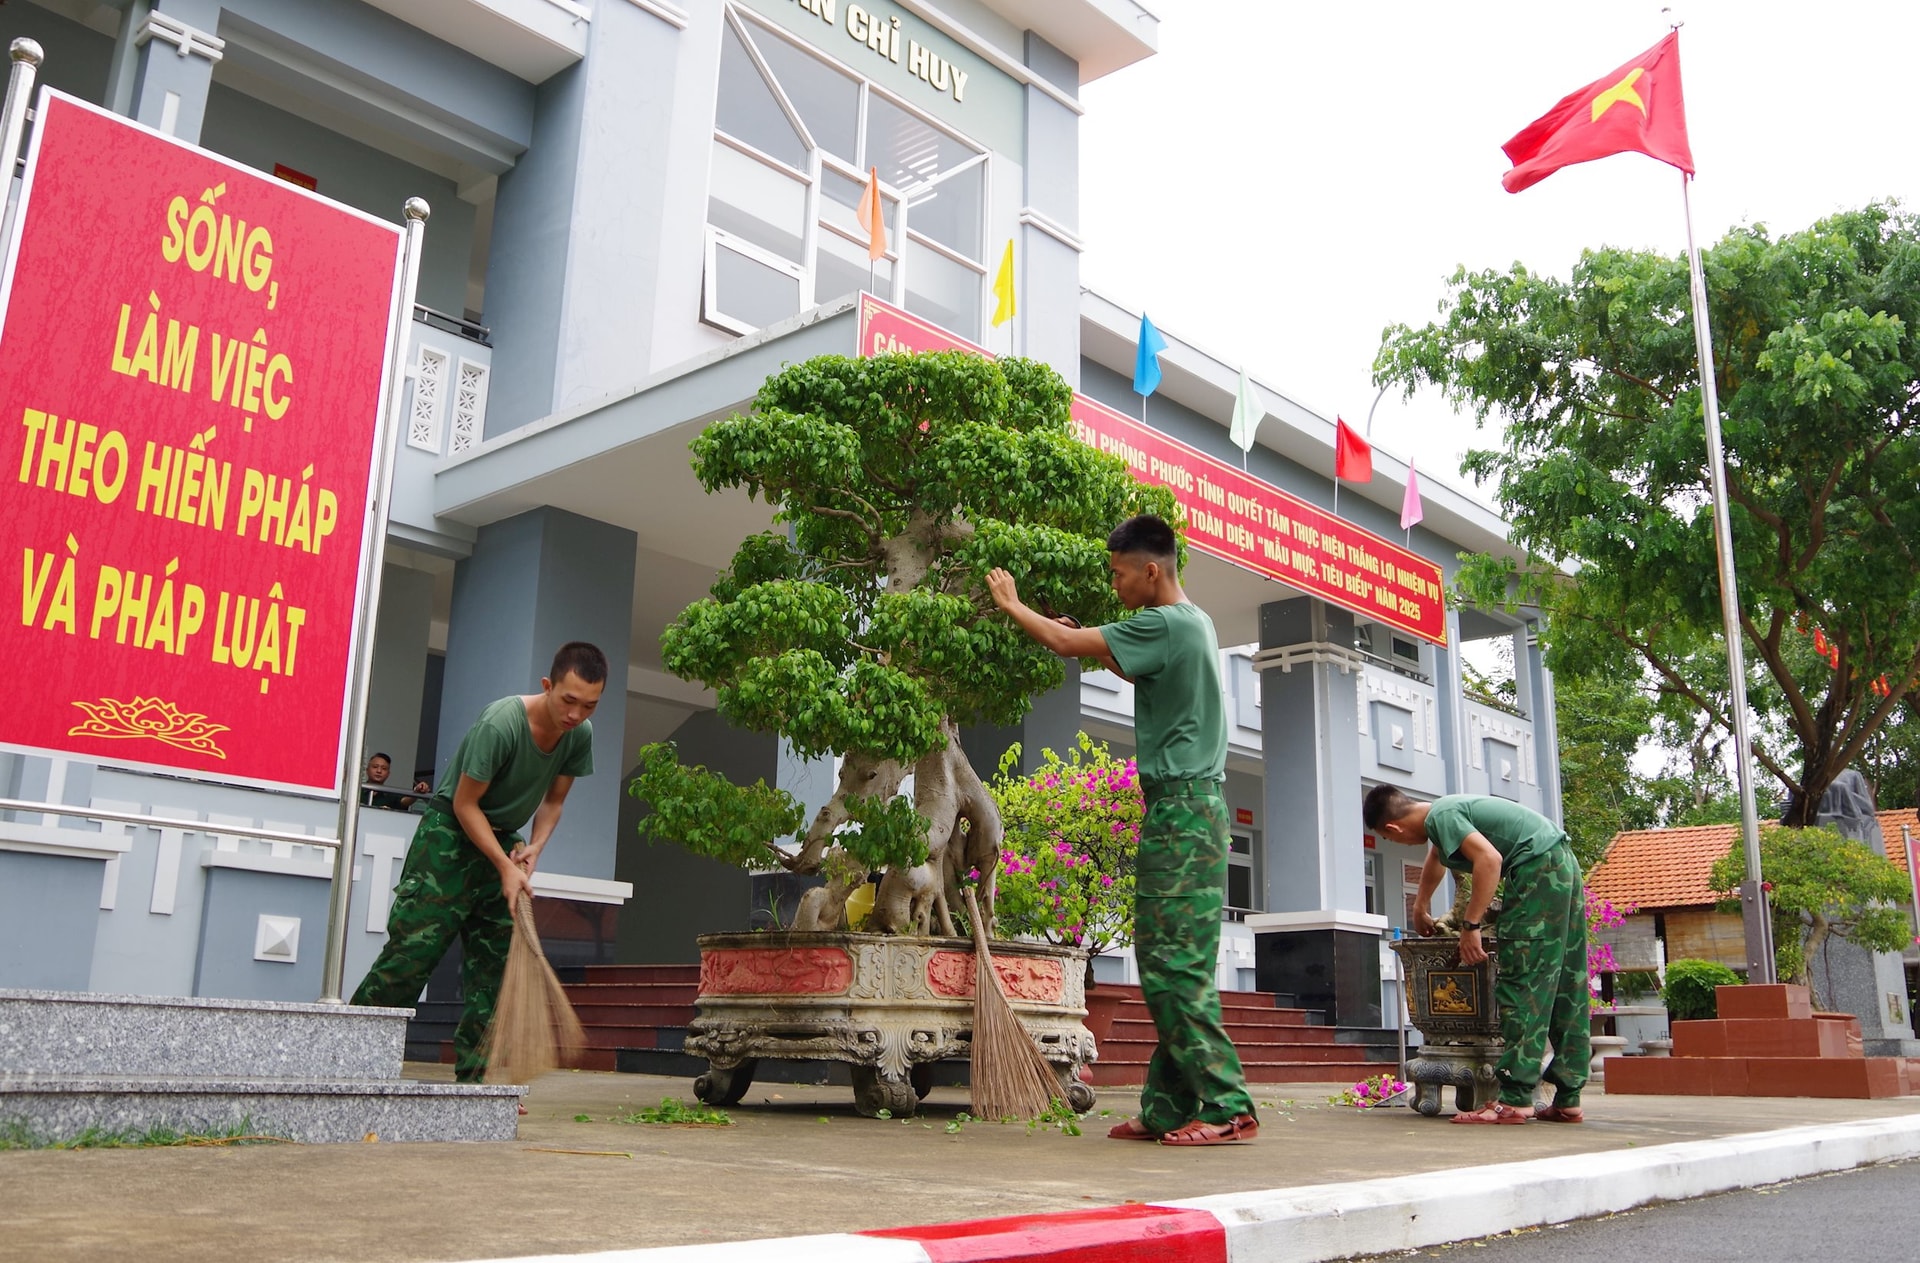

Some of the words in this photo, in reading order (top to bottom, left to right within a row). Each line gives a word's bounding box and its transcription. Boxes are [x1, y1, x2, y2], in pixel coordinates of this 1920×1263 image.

[846, 3, 901, 63] CHỈ
[907, 39, 968, 102] HUY
[162, 181, 279, 310] SỐNG,
[111, 290, 199, 393] LÀM
[211, 328, 293, 432] VIỆC
[18, 407, 129, 504] THEO
[136, 425, 232, 531] HIẾN
[236, 463, 338, 555] PHÁP
[1150, 456, 1194, 493] PHƯỚC
[1227, 491, 1263, 524] QUYẾT
[1265, 508, 1290, 536] TÂM
[1292, 520, 1319, 549] THỰC
[1321, 533, 1345, 560] HIỆN
[1347, 545, 1379, 575] THẮNG
[1380, 560, 1395, 584] LỢI
[1397, 568, 1426, 596] NHIỆM
[1427, 581, 1439, 605] VỤ
[21, 532, 80, 635] VÀ
[90, 556, 205, 656] PHÁP
[212, 582, 306, 694] LUẬT
[1190, 507, 1224, 539] TOÀN
[1226, 522, 1254, 552] DIỆN
[1321, 562, 1343, 588] TIÊU
[1375, 586, 1397, 611] NĂM
[1399, 597, 1421, 621] 2025
